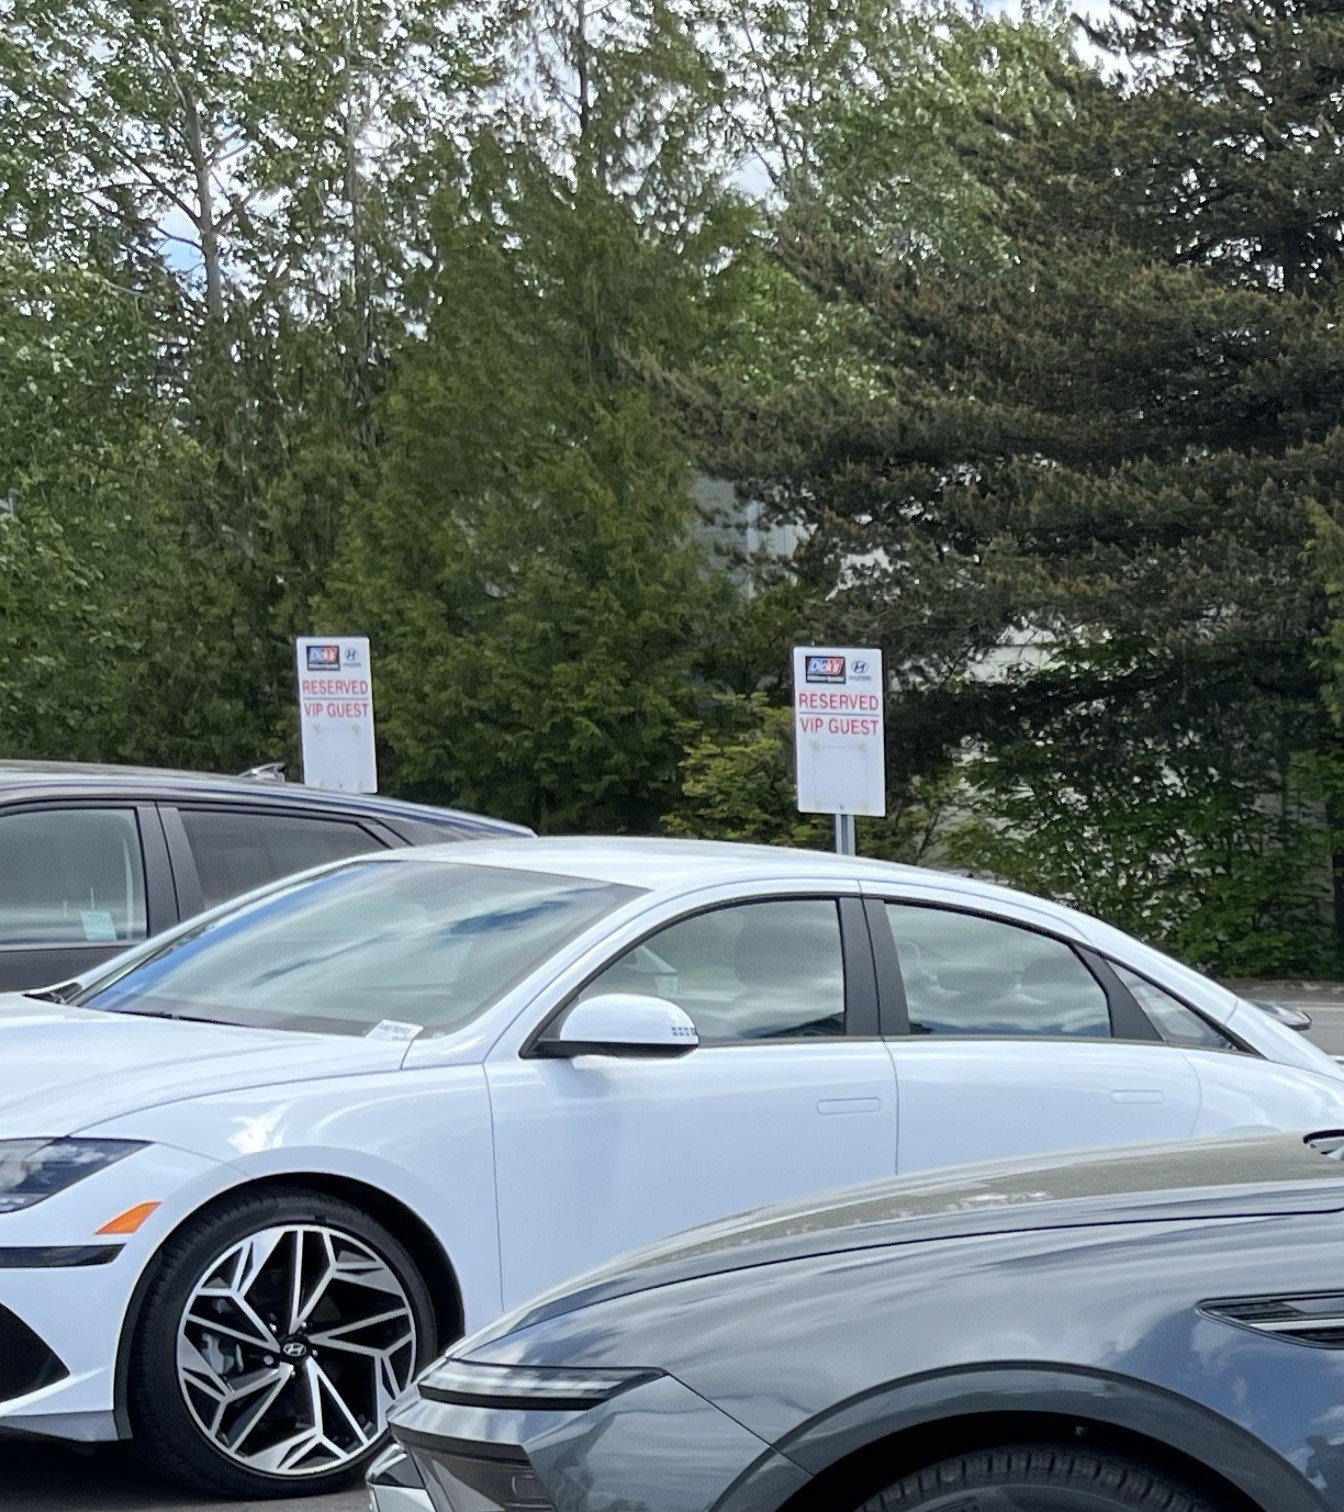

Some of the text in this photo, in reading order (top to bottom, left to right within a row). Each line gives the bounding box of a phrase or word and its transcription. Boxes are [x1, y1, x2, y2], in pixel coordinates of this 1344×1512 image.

[302, 679, 369, 695] RESERVED
[304, 703, 369, 718] VIP GUEST
[798, 693, 879, 711] RESERVED
[800, 717, 879, 736] VIP GUEST
